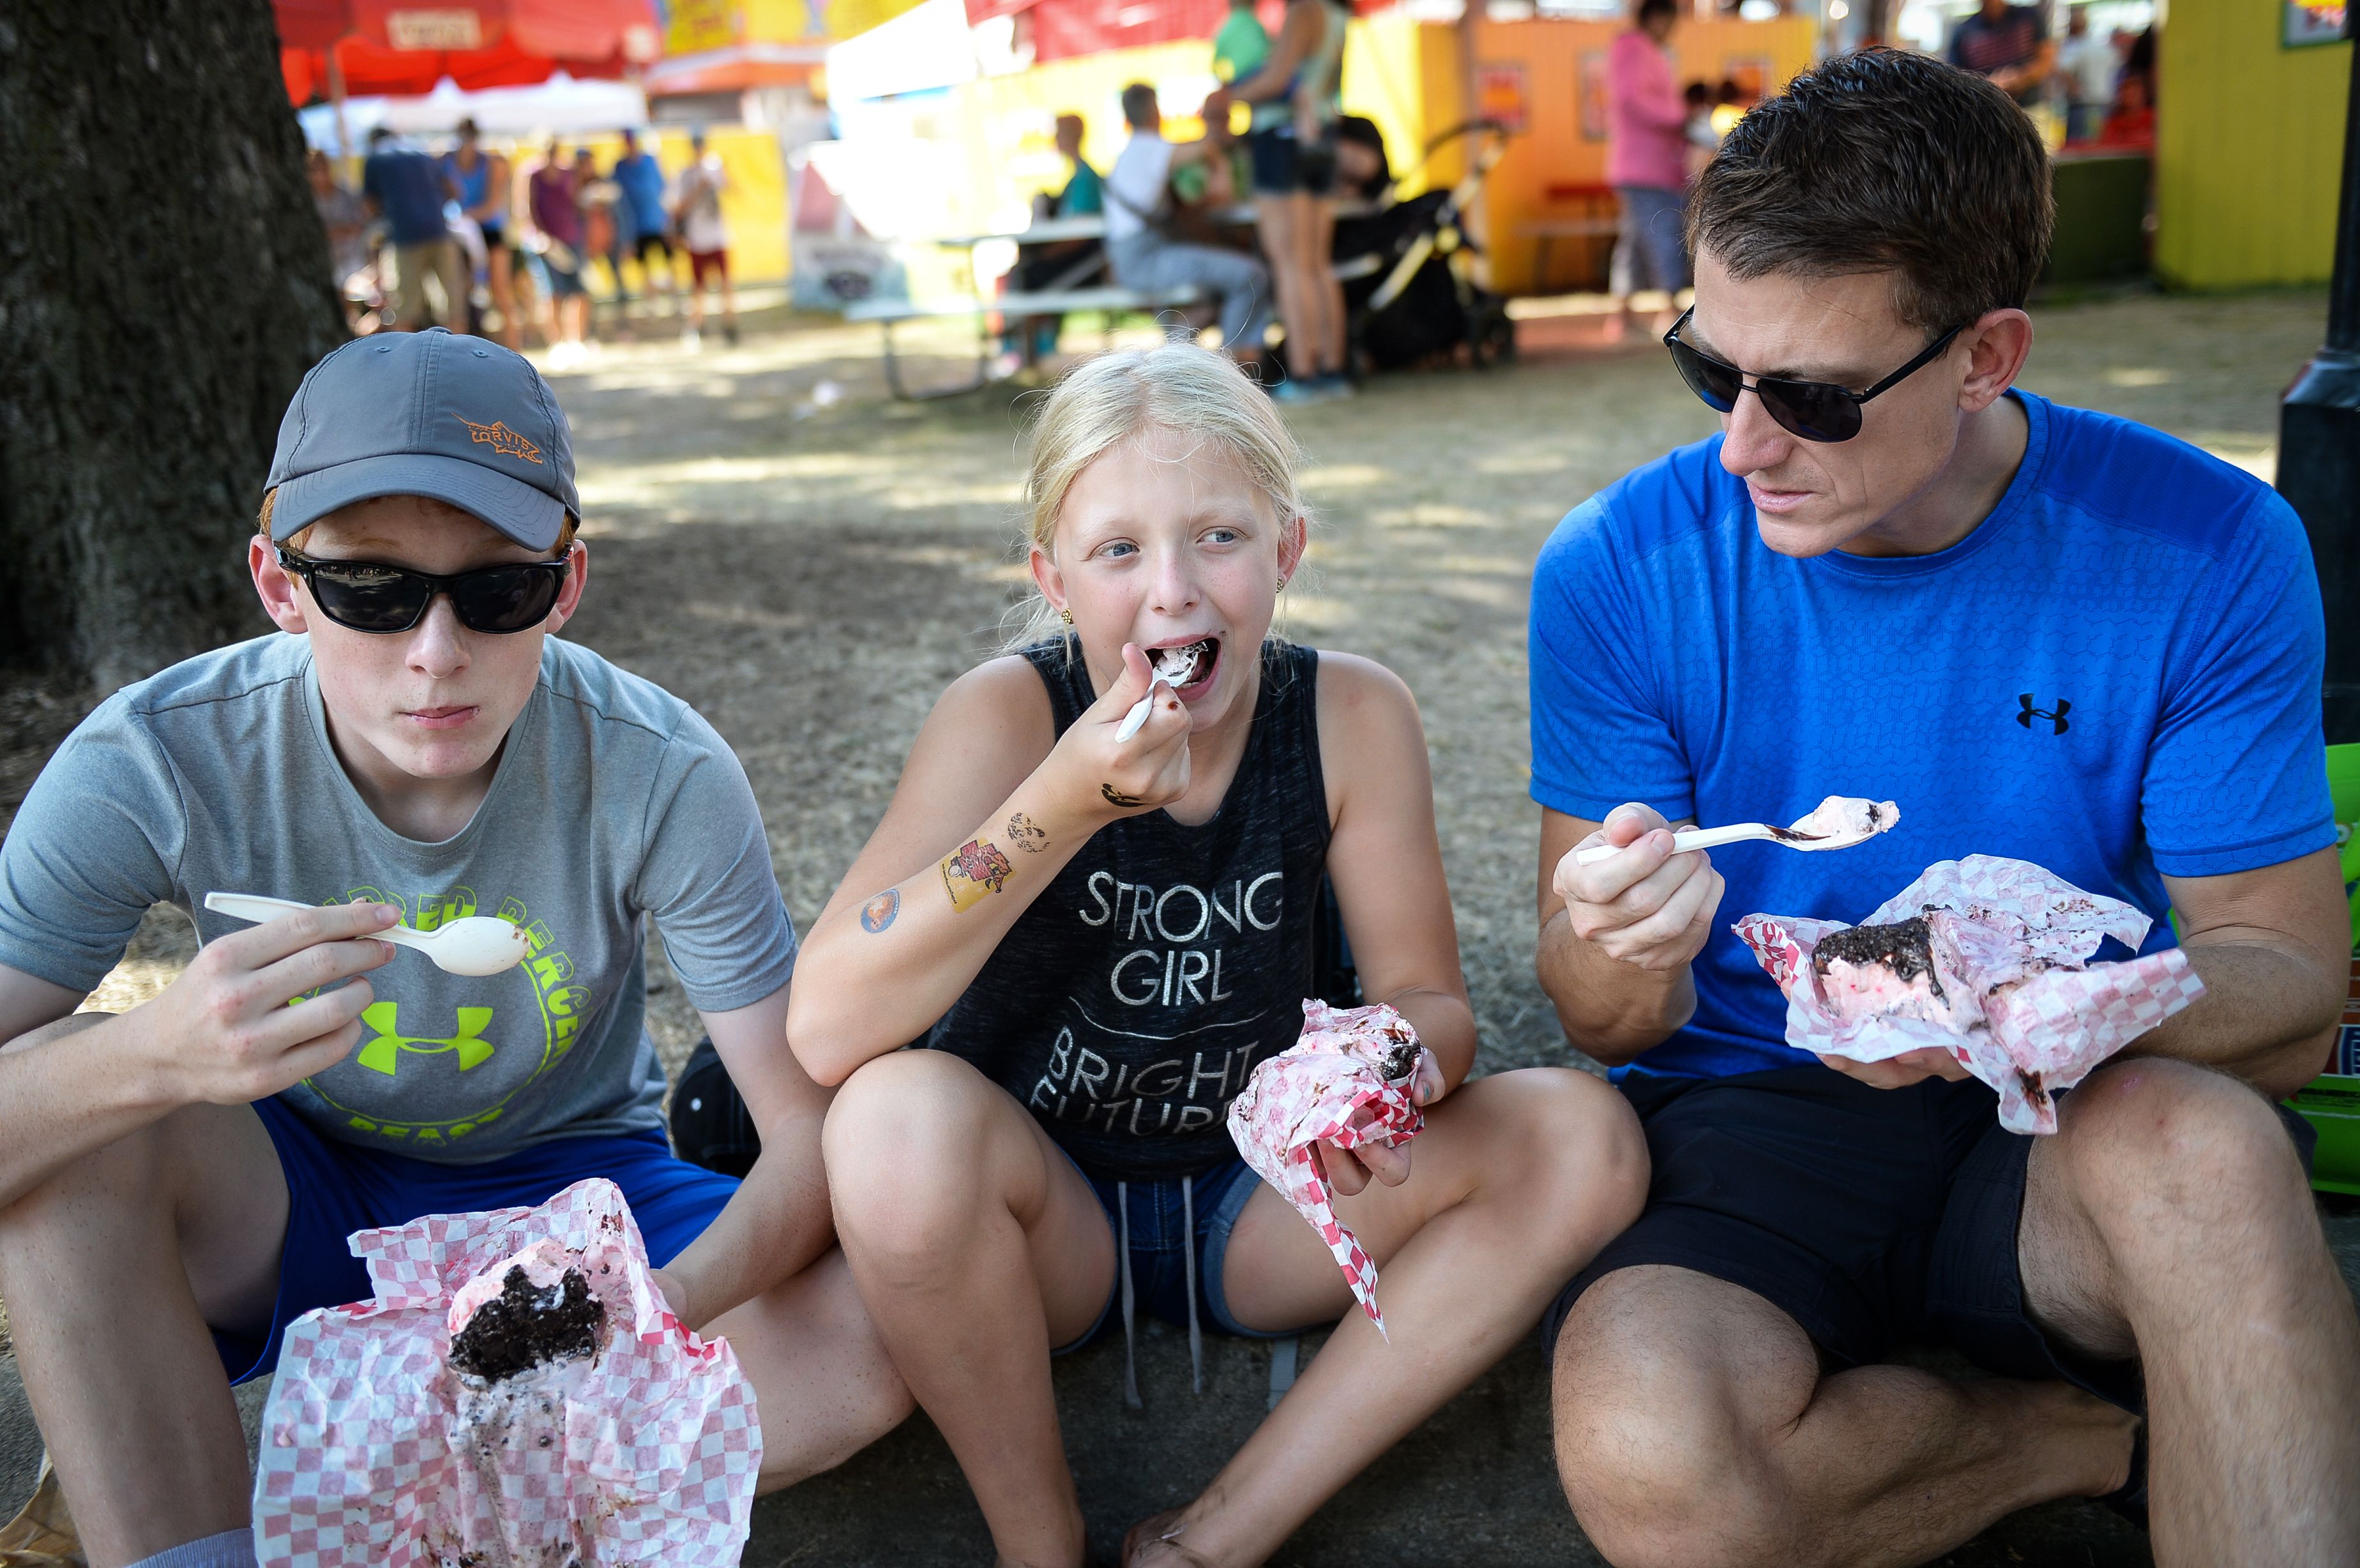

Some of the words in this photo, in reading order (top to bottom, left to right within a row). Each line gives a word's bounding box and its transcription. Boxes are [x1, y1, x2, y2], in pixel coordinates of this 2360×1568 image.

[479, 431, 529, 451] ORVIS
[1079, 871, 1283, 942] STRONG
[1111, 949, 1232, 1006] GIRL
[1048, 1025, 1259, 1100] BRIGHT
